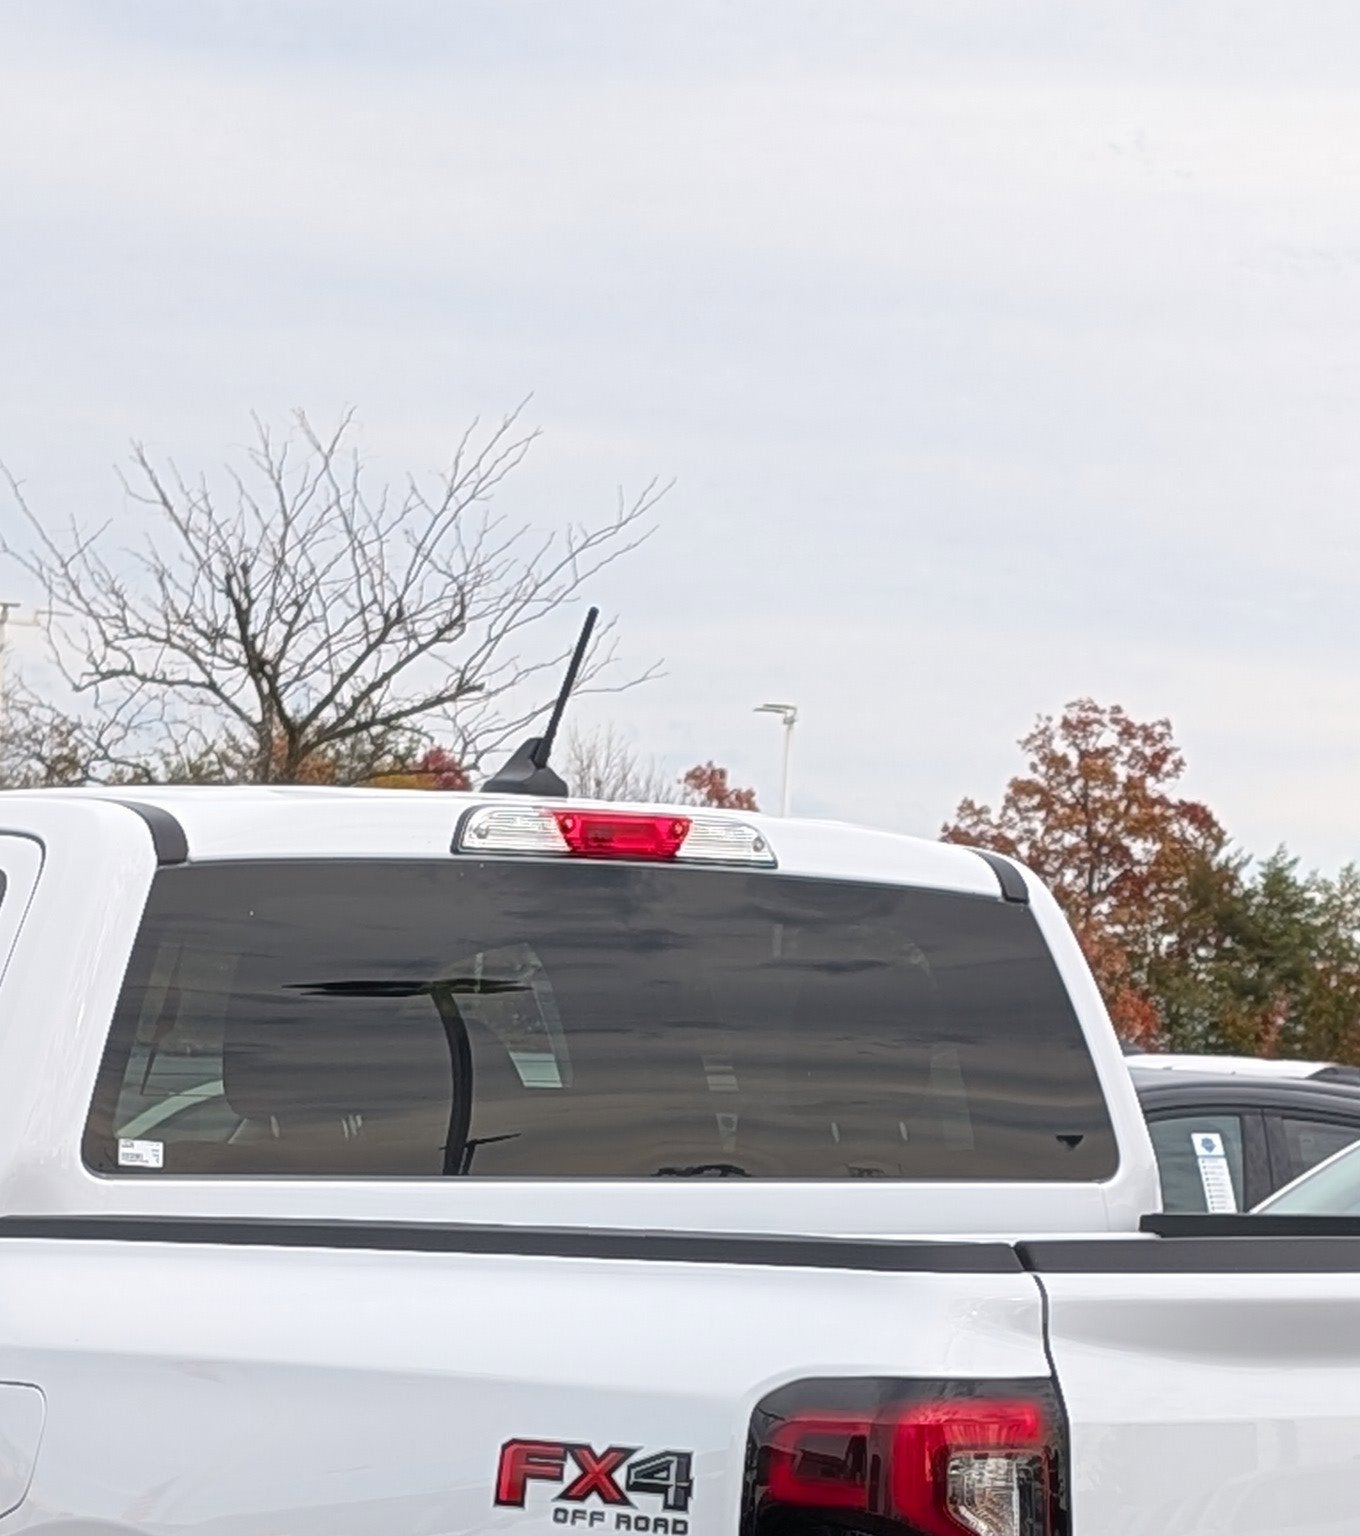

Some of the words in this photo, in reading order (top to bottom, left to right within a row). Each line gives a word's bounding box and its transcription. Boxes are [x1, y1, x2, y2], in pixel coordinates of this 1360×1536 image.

[493, 1438, 695, 1514] FX4
[552, 1507, 606, 1528] OFF
[615, 1513, 689, 1536] ROAD
